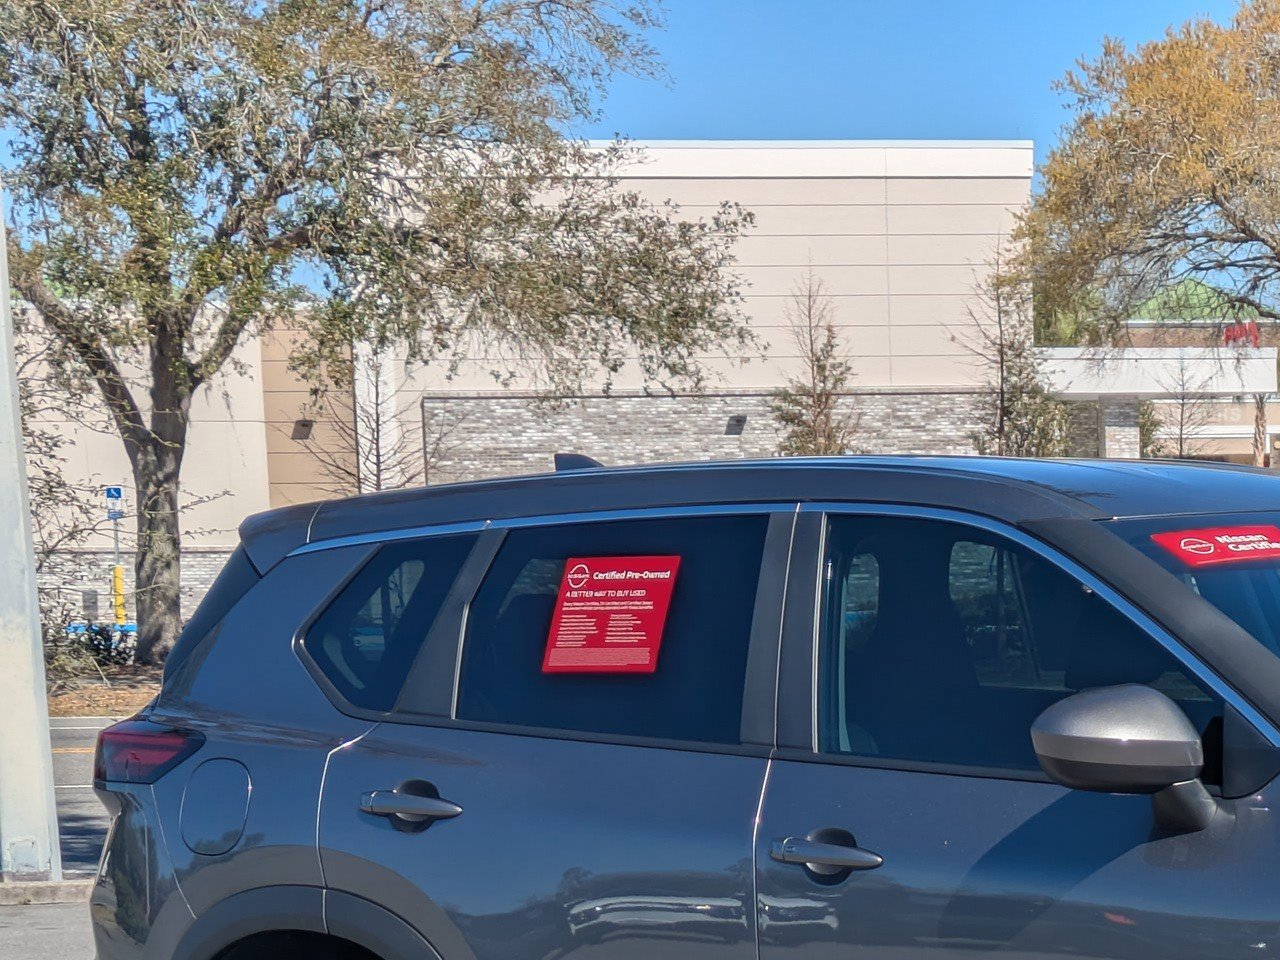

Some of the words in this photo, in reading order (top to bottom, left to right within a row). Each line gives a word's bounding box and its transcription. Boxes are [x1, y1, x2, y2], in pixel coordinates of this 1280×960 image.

[1214, 534, 1268, 543] Nissan
[593, 570, 626, 580] Certified
[626, 570, 670, 579] Pre-Owned
[630, 589, 646, 597] USED
